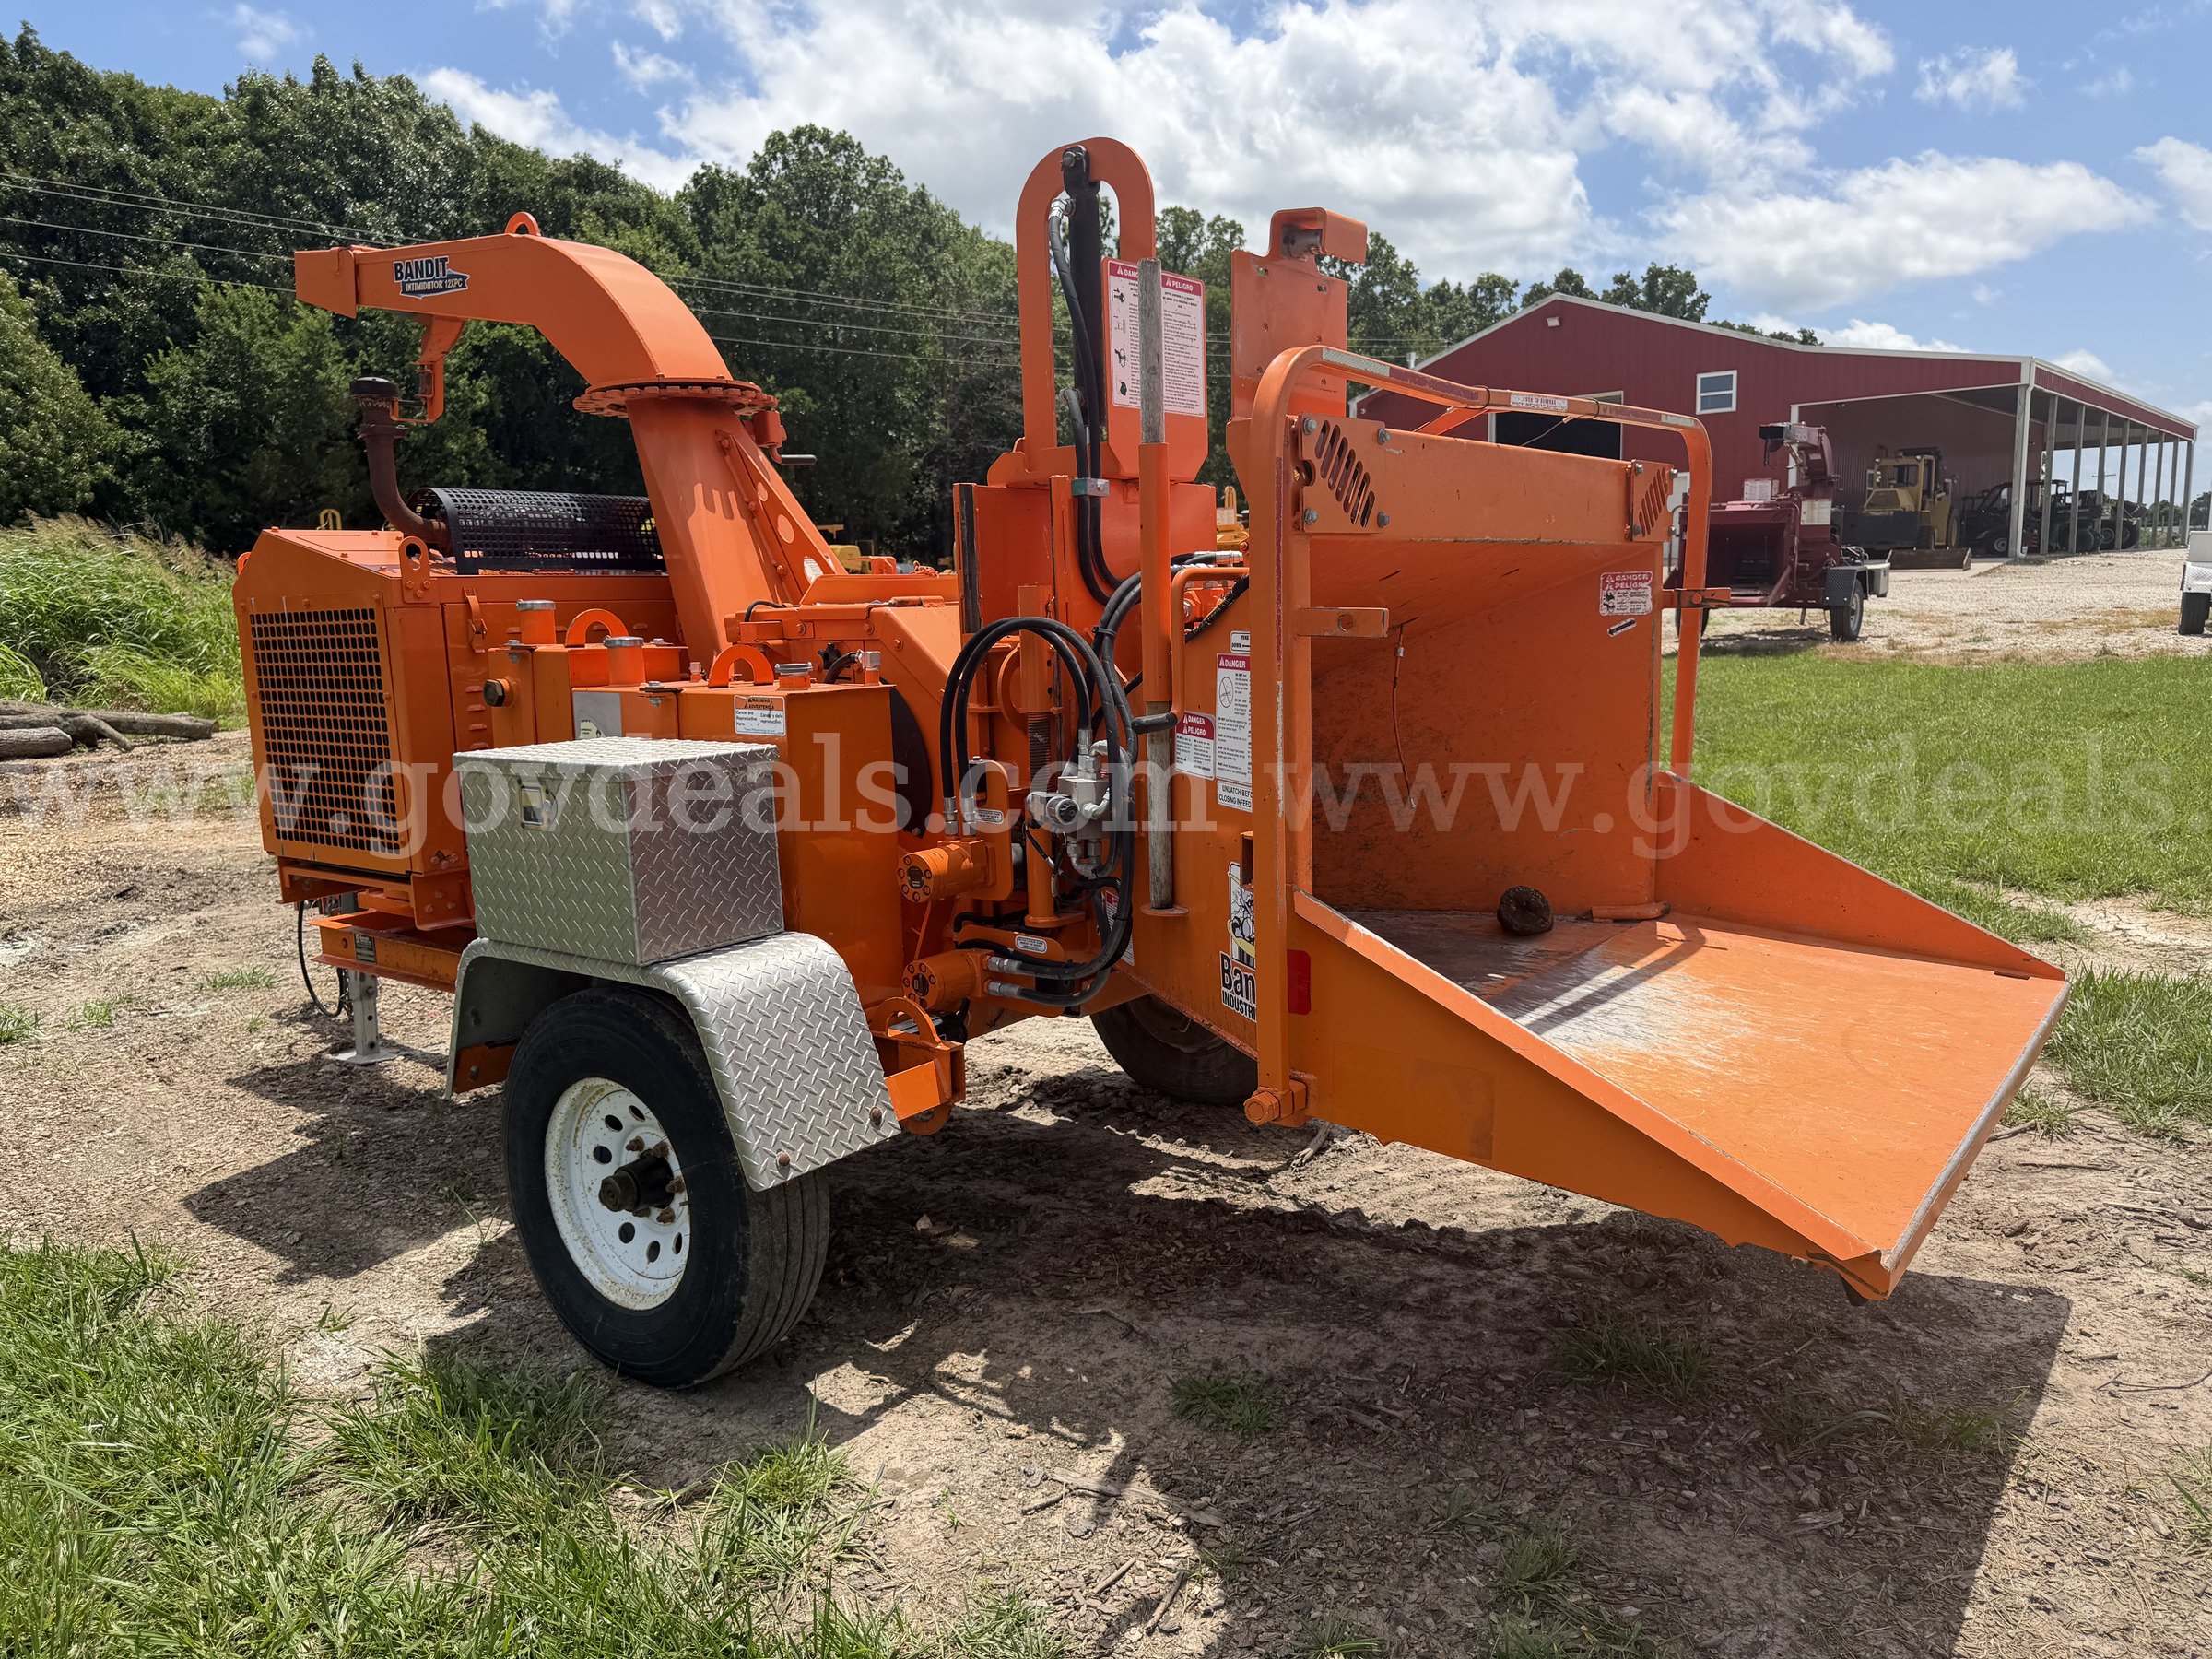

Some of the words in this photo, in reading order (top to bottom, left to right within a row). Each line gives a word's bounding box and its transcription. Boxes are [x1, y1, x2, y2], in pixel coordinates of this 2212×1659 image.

[394, 256, 449, 282] BANDIT
[406, 281, 442, 292] INTIMIDATOR
[444, 278, 463, 288] 12XPC
[1172, 280, 1194, 292] PELIGRO
[1225, 659, 1246, 668] DANGER
[1188, 715, 1206, 725] DANGER
[1188, 726, 1206, 736] PELIGRO
[1221, 784, 1241, 795] UNLATCH
[1218, 794, 1237, 805] CLOSING
[1237, 797, 1252, 808] INFEED
